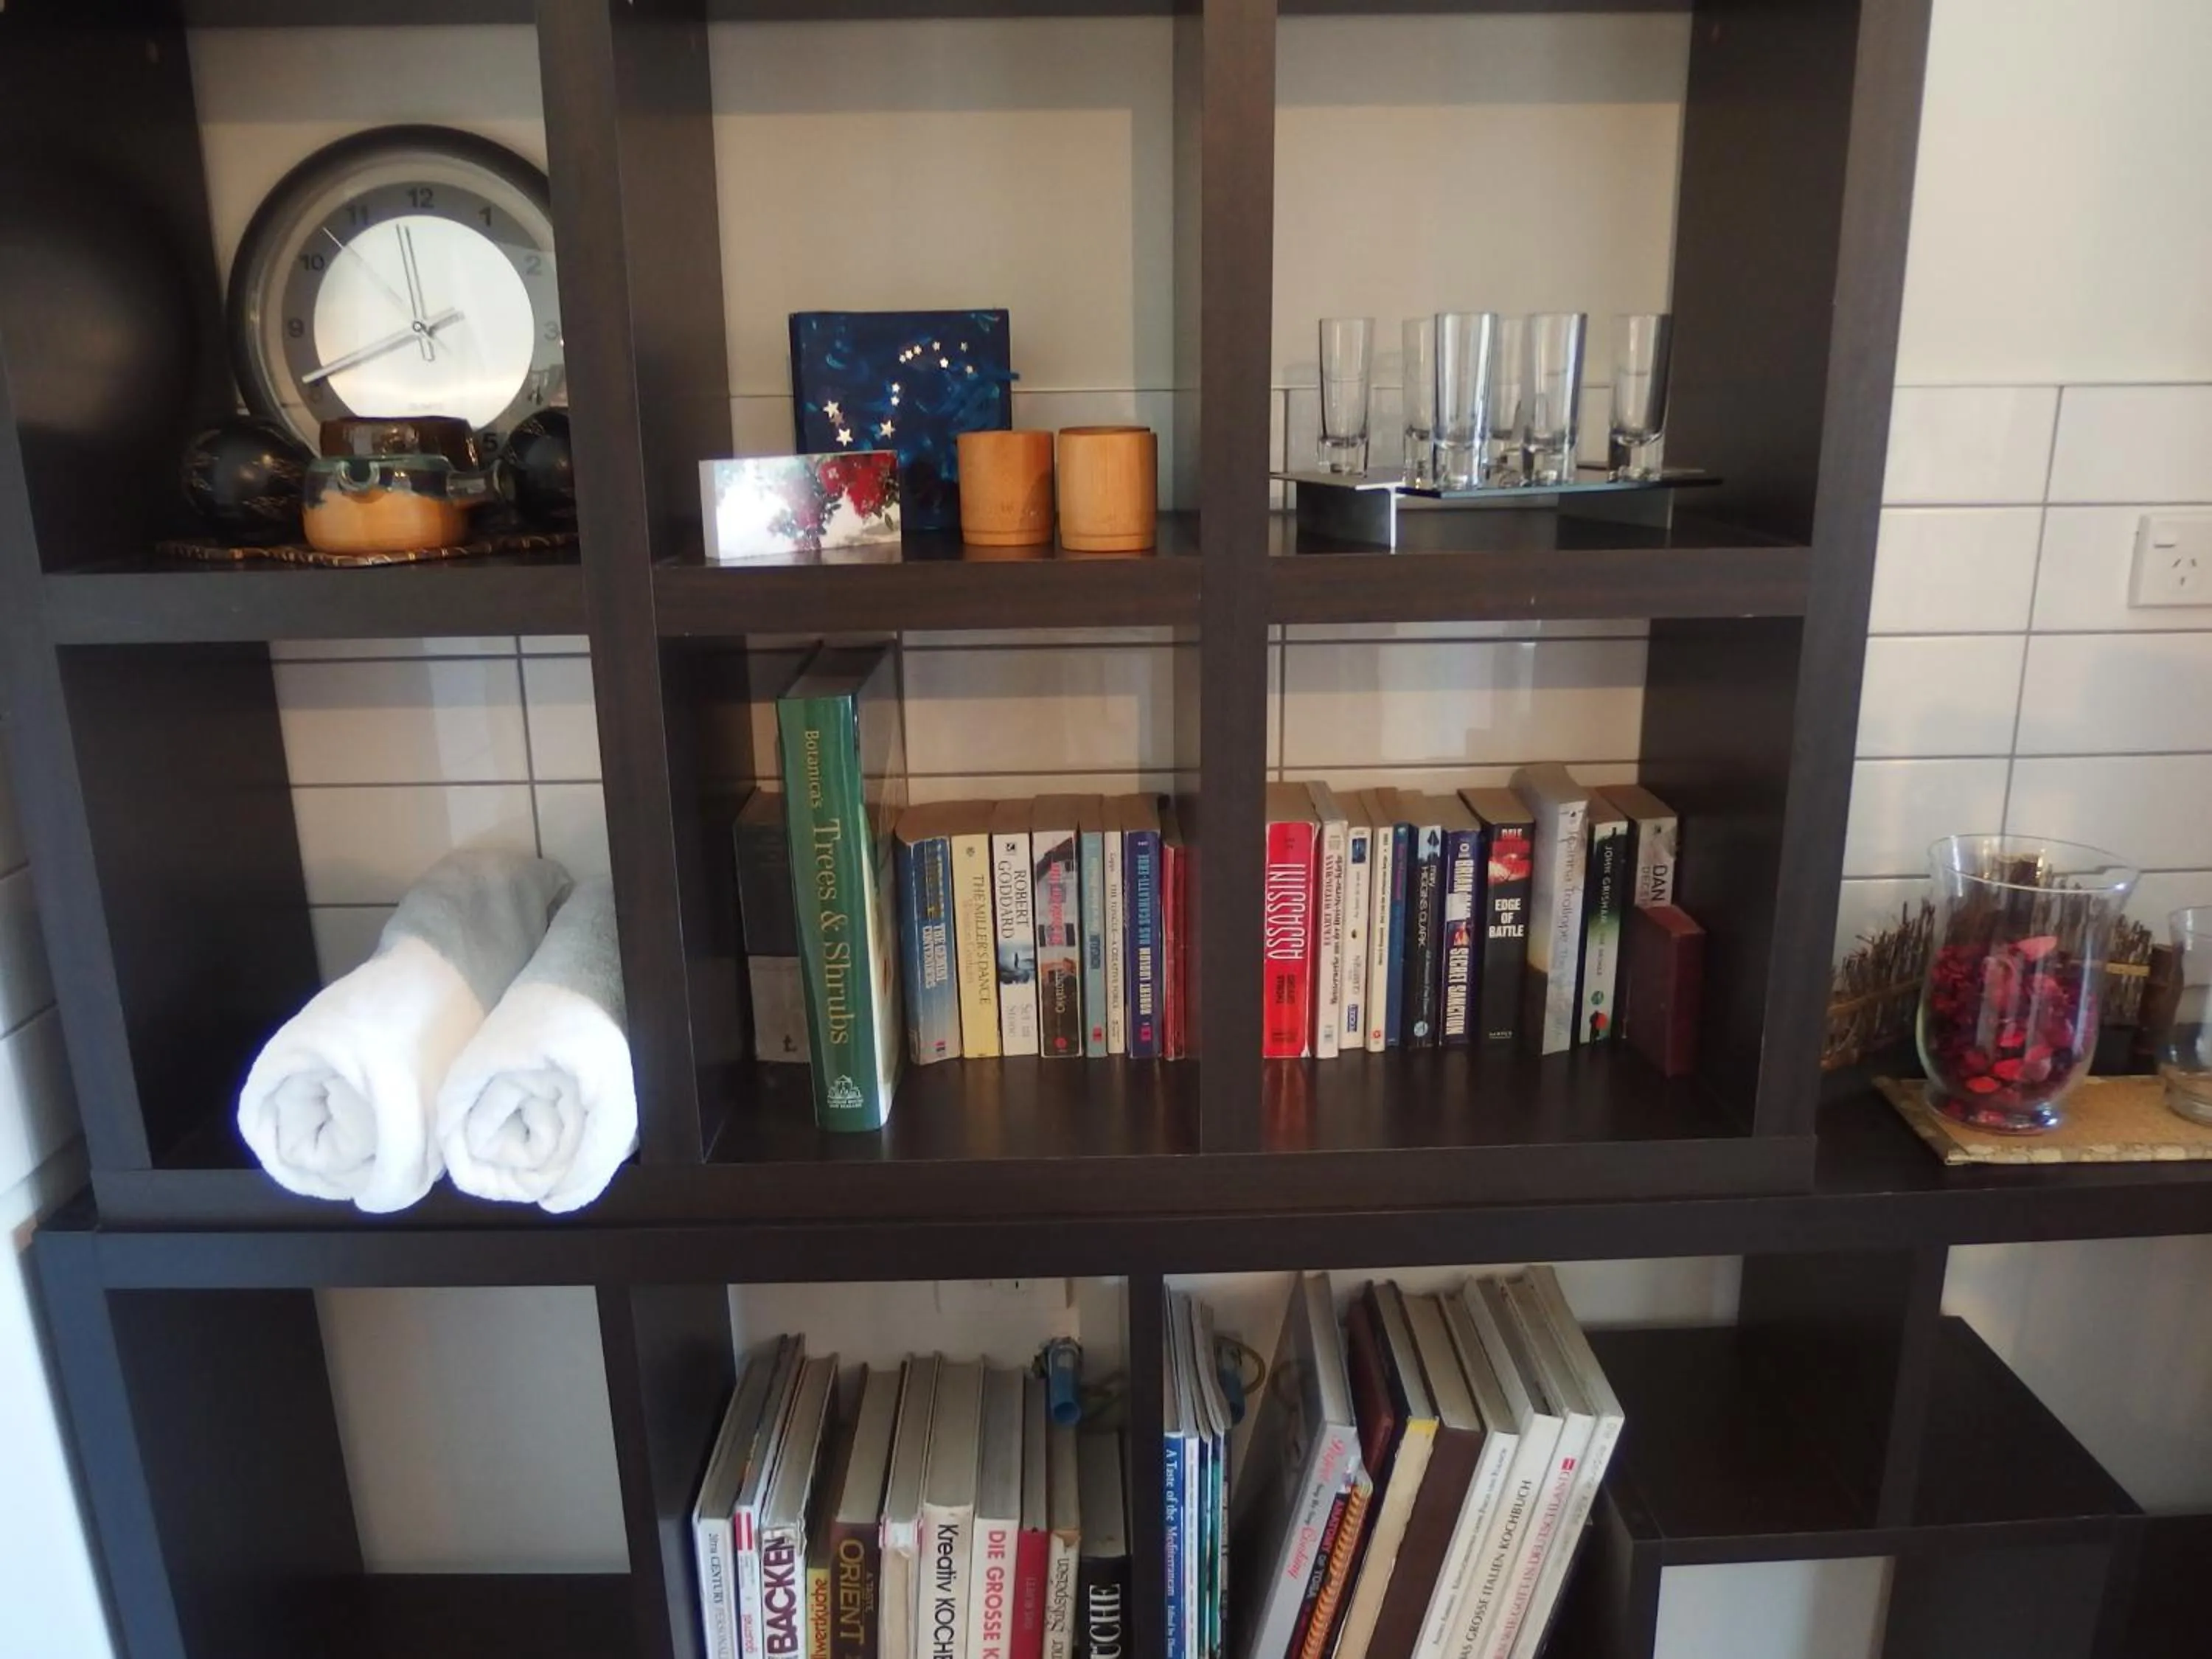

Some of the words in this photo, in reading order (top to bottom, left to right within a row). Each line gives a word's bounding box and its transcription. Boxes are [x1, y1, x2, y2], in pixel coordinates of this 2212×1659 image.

[347, 205, 369, 226] 11
[408, 187, 434, 208] 12
[478, 206, 492, 227] 1
[301, 254, 325, 271] 10
[525, 255, 542, 276] 2
[288, 318, 304, 338] 9
[543, 321, 559, 340] 3
[483, 432, 498, 452] 5
[805, 730, 824, 809] Botanica's
[813, 818, 842, 900] Trees
[1453, 859, 1475, 893] BRIAN
[1604, 846, 1613, 874] JOHN
[973, 874, 986, 901] THE
[998, 860, 1015, 939] GODDARD
[1014, 870, 1029, 927] ROBERT
[1419, 866, 1428, 911] HIGGINS
[1600, 876, 1612, 922] GRISHAM
[1651, 864, 1668, 901] DAN
[820, 911, 848, 933] &
[1267, 863, 1307, 959] ASSASSINI
[1495, 898, 1521, 911] EDGE
[1500, 912, 1514, 924] OF
[1557, 886, 1575, 942] Trollope
[974, 901, 990, 959] MILLER'S
[1418, 911, 1427, 947] CLARK
[1489, 925, 1524, 939] BATTLE
[978, 960, 992, 1005] DANCE
[1448, 947, 1469, 983] SECRET
[823, 942, 855, 1045] Shrubs
[1445, 984, 1467, 1036] SANCTION
[1166, 1449, 1178, 1458] A
[1166, 1460, 1178, 1487] Taste
[1166, 1490, 1179, 1504] of
[1166, 1505, 1178, 1521] the
[1527, 1471, 1571, 1563] DEUTSCHLAND
[936, 1524, 959, 1593] Kreativ
[987, 1530, 1006, 1559] DIE
[1166, 1525, 1178, 1596] Mediterranean
[1465, 1597, 1490, 1642] GROSSE
[1481, 1553, 1506, 1595] ITALIEN
[1498, 1479, 1532, 1550] KOCHBUCH
[710, 1556, 724, 1604] CENTURY
[763, 1537, 799, 1654] BACKEN
[840, 1539, 865, 1646] ORIENT
[983, 1566, 1004, 1641] GROSSE
